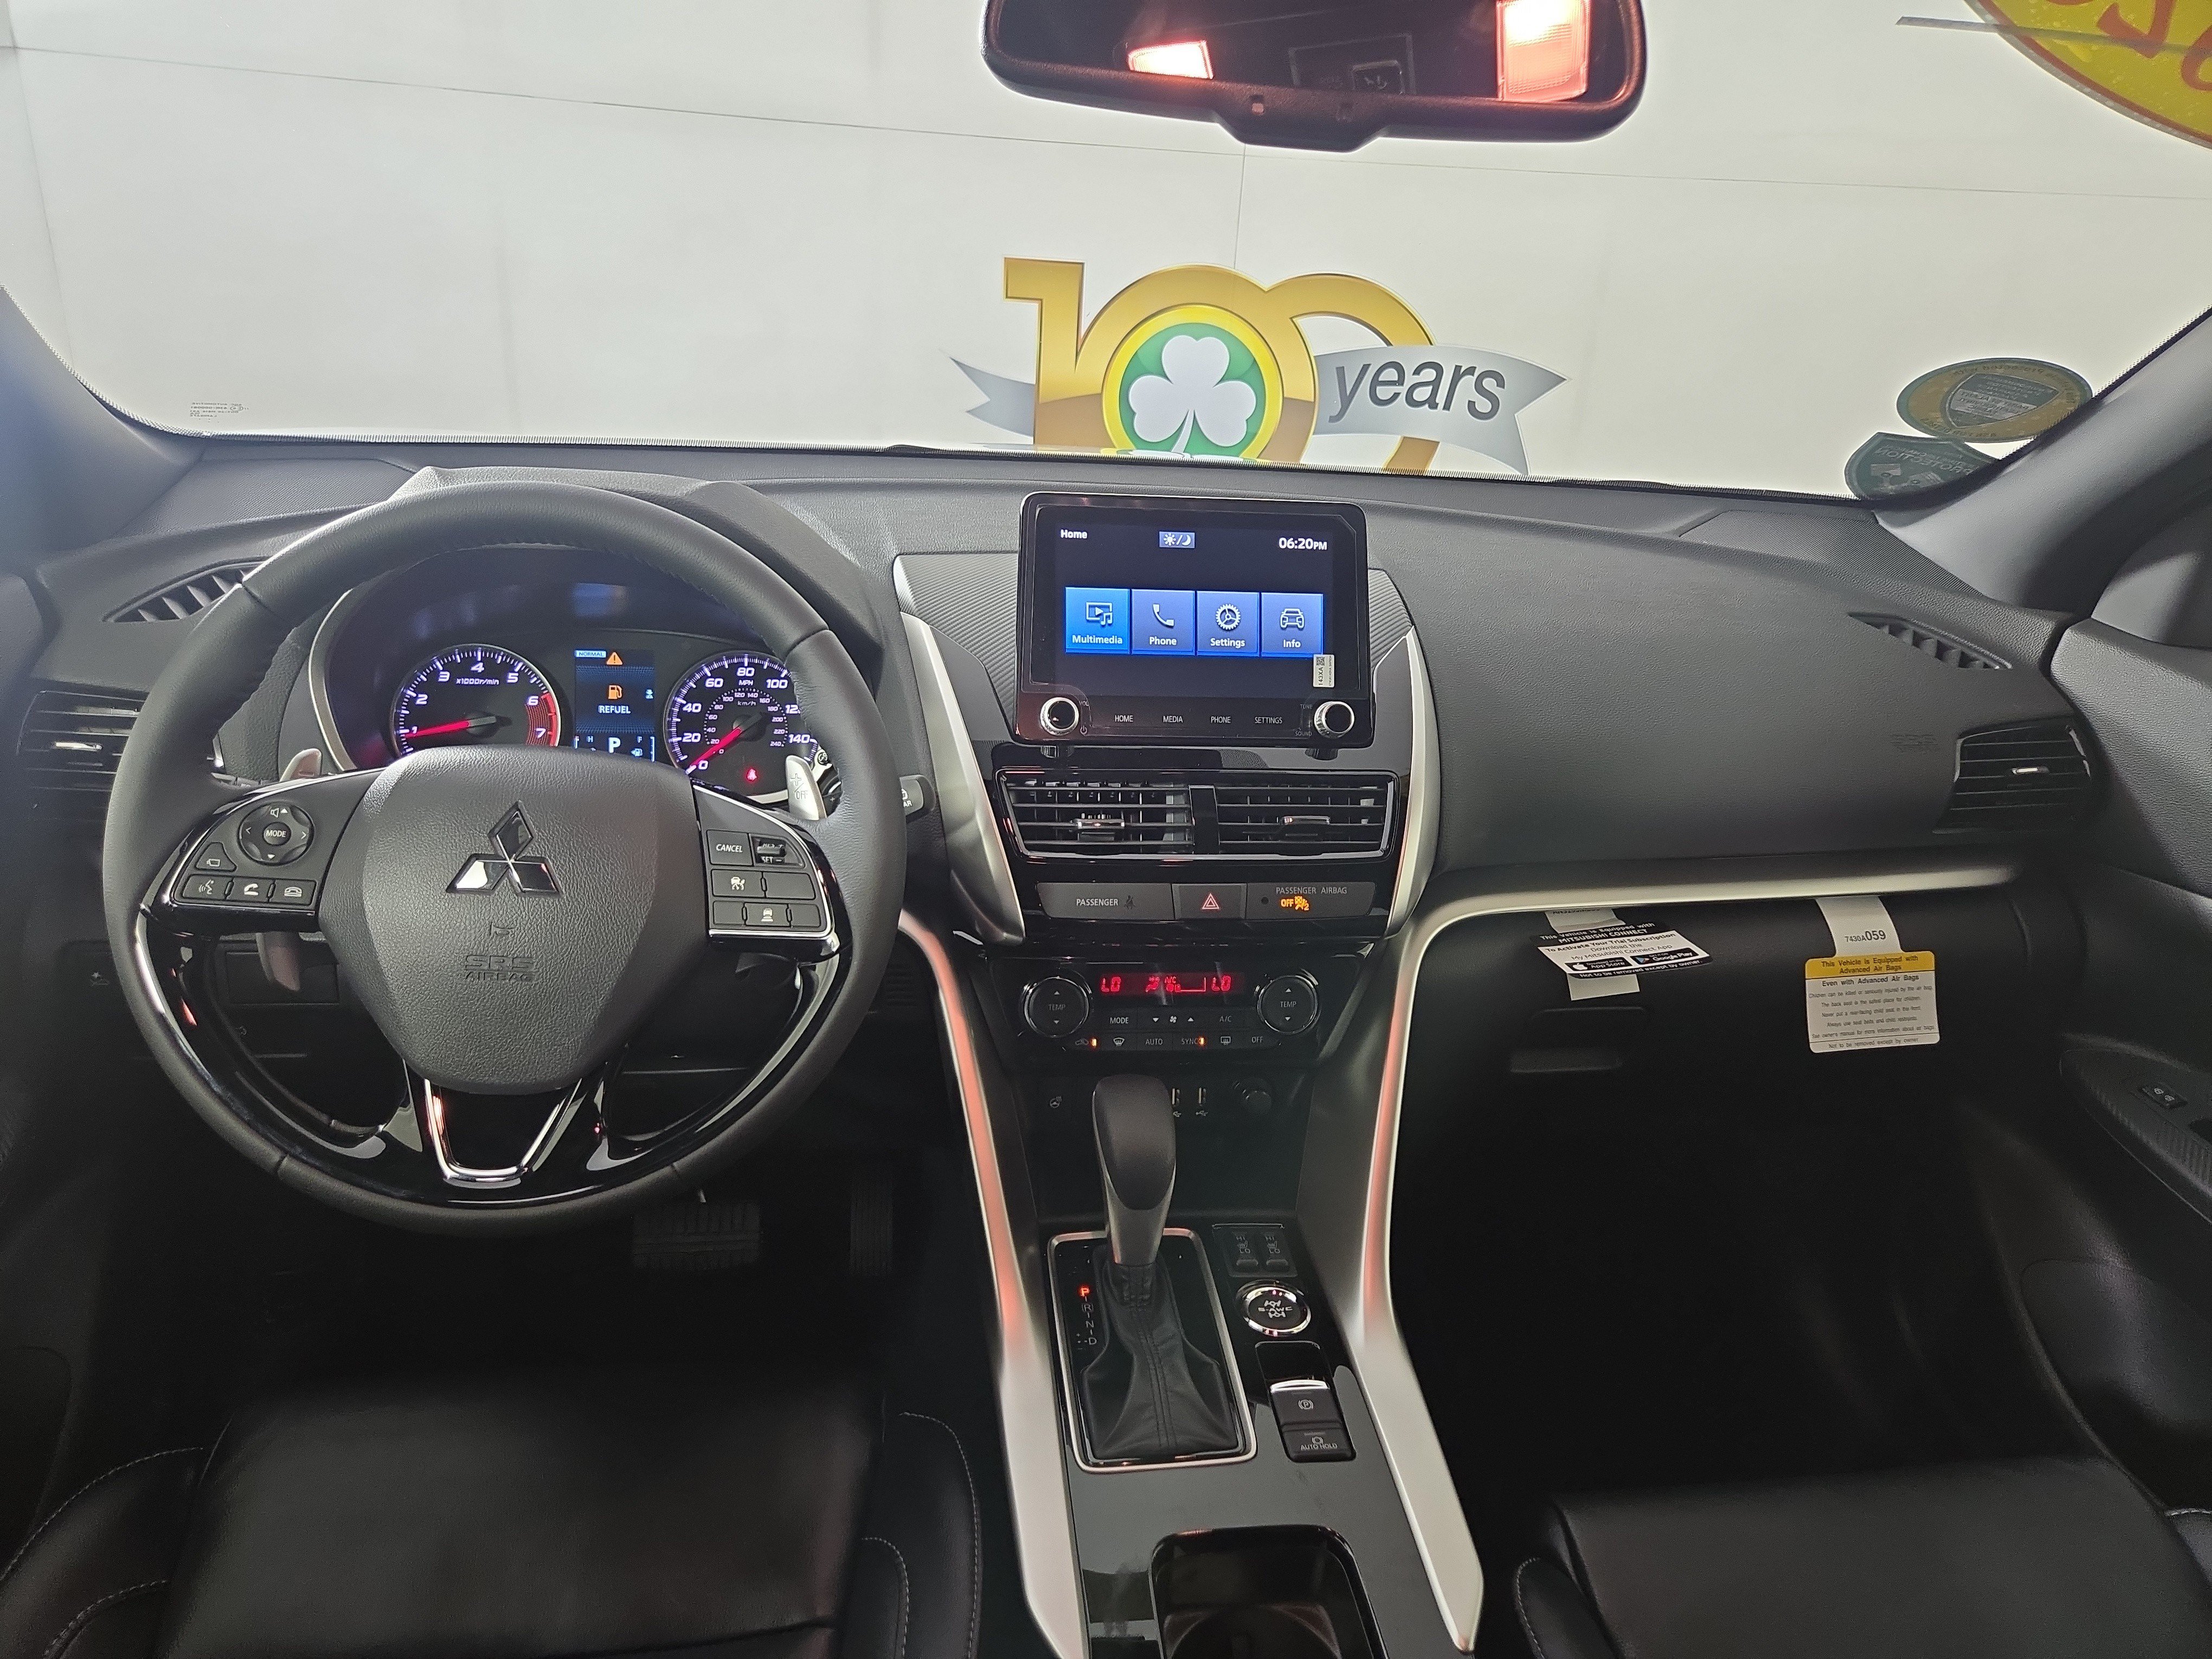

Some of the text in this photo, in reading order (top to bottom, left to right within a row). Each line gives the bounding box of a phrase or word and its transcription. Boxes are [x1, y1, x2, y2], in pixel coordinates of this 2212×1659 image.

[1328, 360, 1507, 424] years
[1060, 529, 1088, 539] Home
[1278, 537, 1327, 550] 06:20PM
[1072, 634, 1123, 645] Multimedia
[1149, 635, 1177, 646] Phone
[1210, 637, 1246, 649] Settings
[1283, 639, 1301, 648] Info
[471, 662, 485, 673] 4
[736, 667, 755, 677] 80
[438, 671, 451, 682] 3
[506, 672, 519, 683] 5
[704, 678, 724, 688] 60
[766, 679, 788, 689] 100
[415, 693, 428, 705] 2
[528, 695, 539, 706] 6
[599, 705, 631, 714] REFUEL
[682, 703, 702, 713] 40
[1115, 714, 1134, 723] HOME
[1162, 715, 1183, 724] MEDIA
[1210, 715, 1231, 724] PHONE
[1254, 716, 1283, 725] SETTINGS
[411, 726, 418, 734] 1
[536, 728, 546, 738] 7
[681, 732, 702, 743] 20
[788, 734, 811, 744] 140
[608, 737, 621, 754] P
[698, 760, 709, 770] 0
[795, 792, 808, 800] OFF
[903, 800, 913, 808] AR
[266, 829, 287, 838] MODE
[716, 844, 743, 853] CANCEL
[1076, 897, 1119, 908] PASSENGER
[1281, 898, 1294, 908] OFF
[1558, 929, 1648, 943] MITSUBISHI CONNECT
[1628, 933, 1676, 942] Subscription
[1844, 929, 1886, 942] 7430A059
[1584, 950, 1624, 959] Mitsubishi
[1652, 953, 1678, 961] Google
[465, 955, 536, 972] SRS
[1872, 956, 1902, 964] Equipped
[1903, 974, 1919, 982] Bags
[1109, 1017, 1129, 1025] MODE
[1251, 1036, 1263, 1044] OFF
[1081, 1287, 1090, 1296] P
[1085, 1321, 1094, 1329] N
[1088, 1337, 1097, 1345] D
